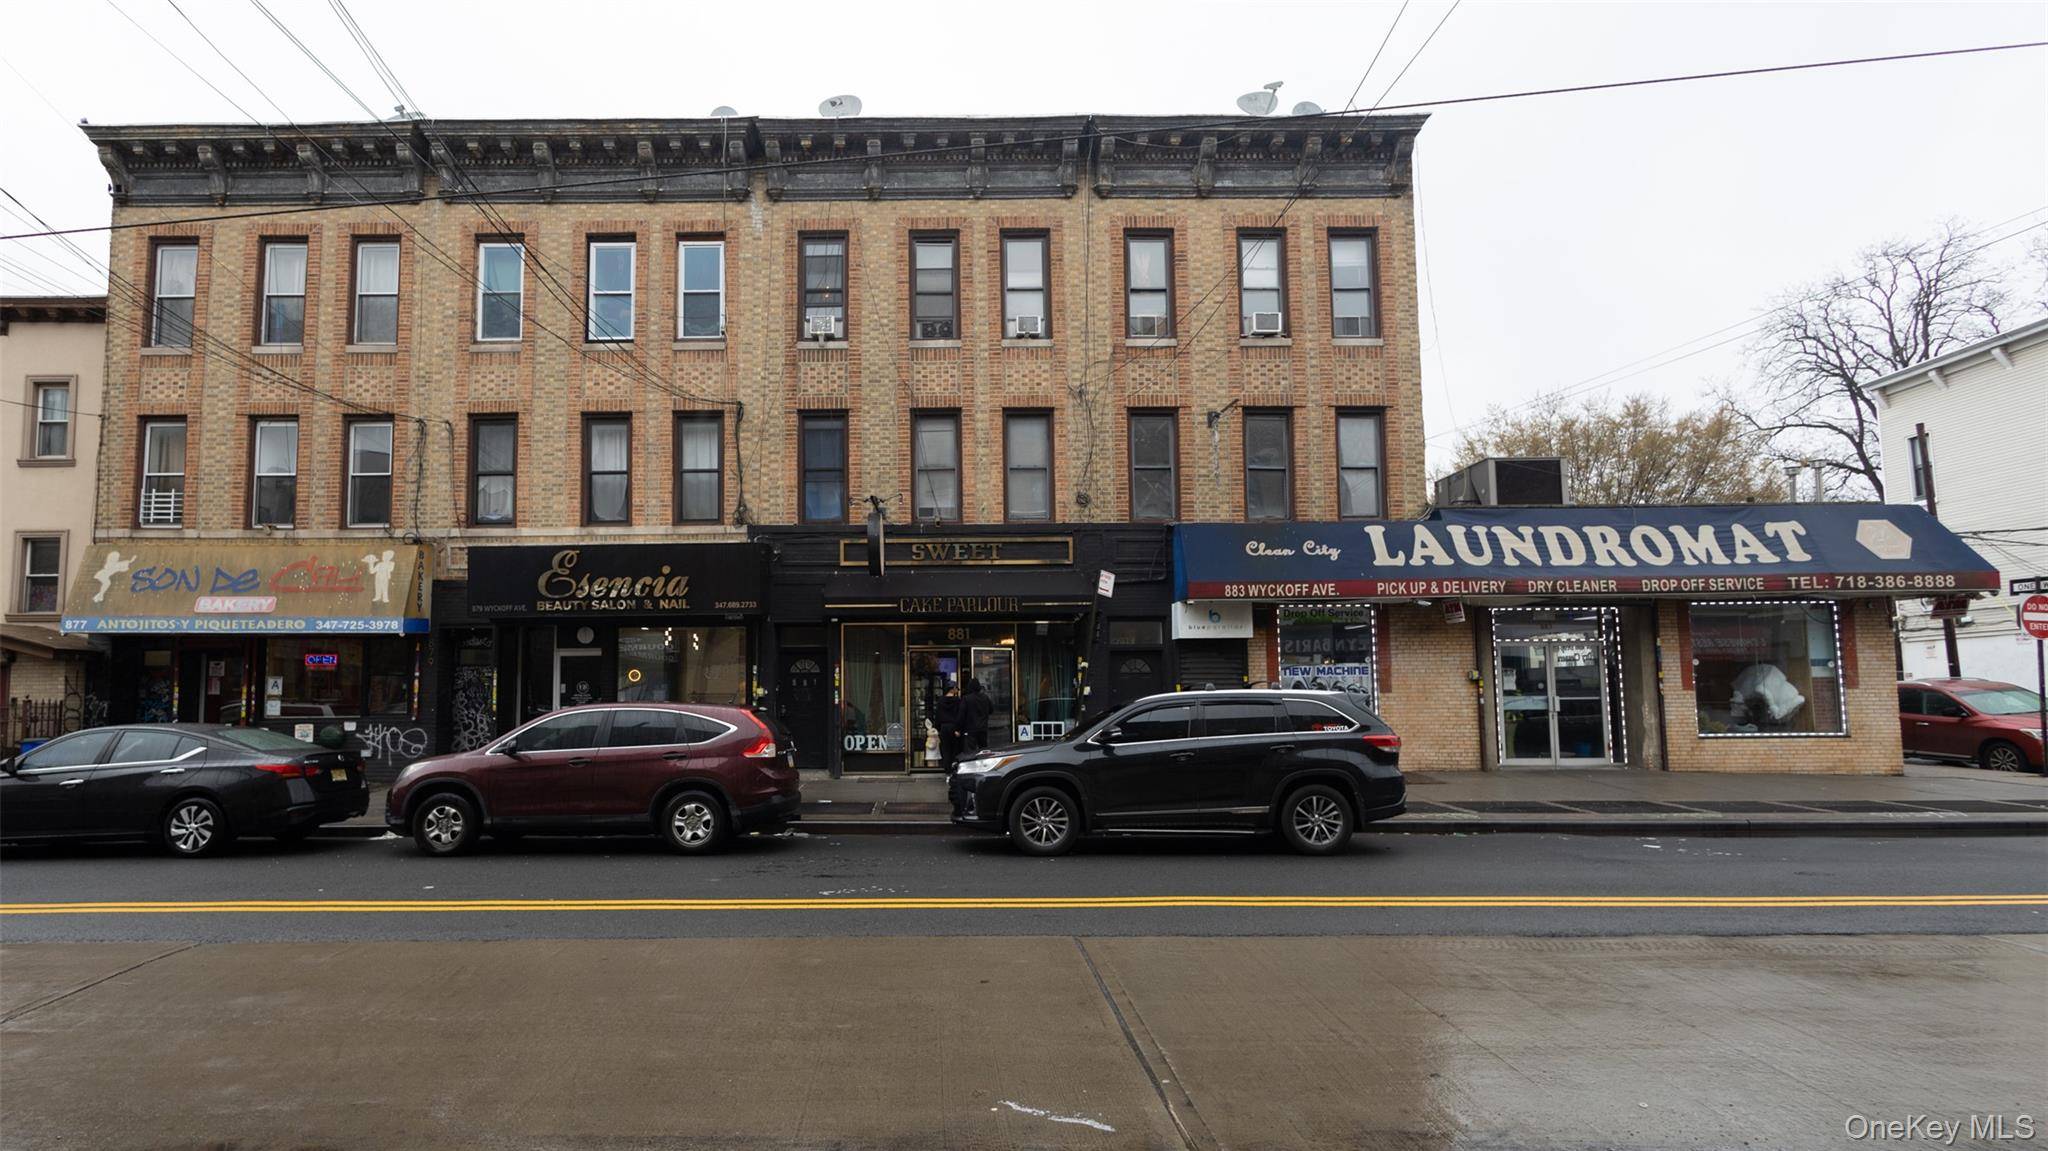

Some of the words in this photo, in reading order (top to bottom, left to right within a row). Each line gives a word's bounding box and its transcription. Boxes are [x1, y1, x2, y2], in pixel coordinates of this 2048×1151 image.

[1246, 541, 1295, 556] Clean
[1303, 540, 1341, 561] City
[1363, 521, 1812, 567] LAUNDROMAT
[911, 543, 1002, 560] SWEET
[130, 566, 200, 592] SON
[537, 550, 690, 599] Esencia
[1377, 582, 1407, 595] PICK
[1410, 581, 1427, 594] UP
[1430, 581, 1439, 593] &
[1443, 580, 1506, 593] DELIVERY
[1528, 580, 1553, 592] DRY
[1556, 579, 1618, 592] CLEANER
[1642, 578, 1677, 591] DROP
[1681, 577, 1705, 591] OFF
[1709, 577, 1765, 590] SERVICE
[1788, 576, 1829, 589] TEL:
[1835, 575, 1956, 588] 718-386-8888
[2018, 582, 2036, 593] ONE
[1225, 584, 1245, 597] 883
[1249, 584, 1309, 597] WYCKOFF
[1312, 583, 1340, 596] AVE.
[197, 599, 273, 612] BAKERY
[537, 600, 590, 611] BEAUTY
[591, 600, 636, 610] SALON
[643, 600, 653, 609] &
[659, 599, 690, 609] NAIL
[900, 597, 942, 612] CAKE
[947, 597, 1018, 612] PARLOUR
[2027, 603, 2038, 611] DO
[2039, 603, 2048, 611] NO
[1283, 610, 1305, 619] Drop
[1310, 609, 1325, 617] Off
[1328, 609, 1363, 617] Service
[65, 620, 87, 630] 877
[97, 619, 176, 630] ANTOJITOS
[180, 620, 189, 629] Y
[194, 619, 306, 629] PIQUETEADERO
[315, 620, 399, 630] 347-725-3978
[2030, 623, 2048, 632] ENTE
[948, 628, 970, 640] 881
[307, 655, 337, 665] OPEN
[1283, 666, 1311, 676] NEW
[1316, 666, 1369, 676] MACHINE
[271, 680, 280, 690] A
[1021, 726, 1029, 736] A
[844, 735, 887, 751] OPEN
